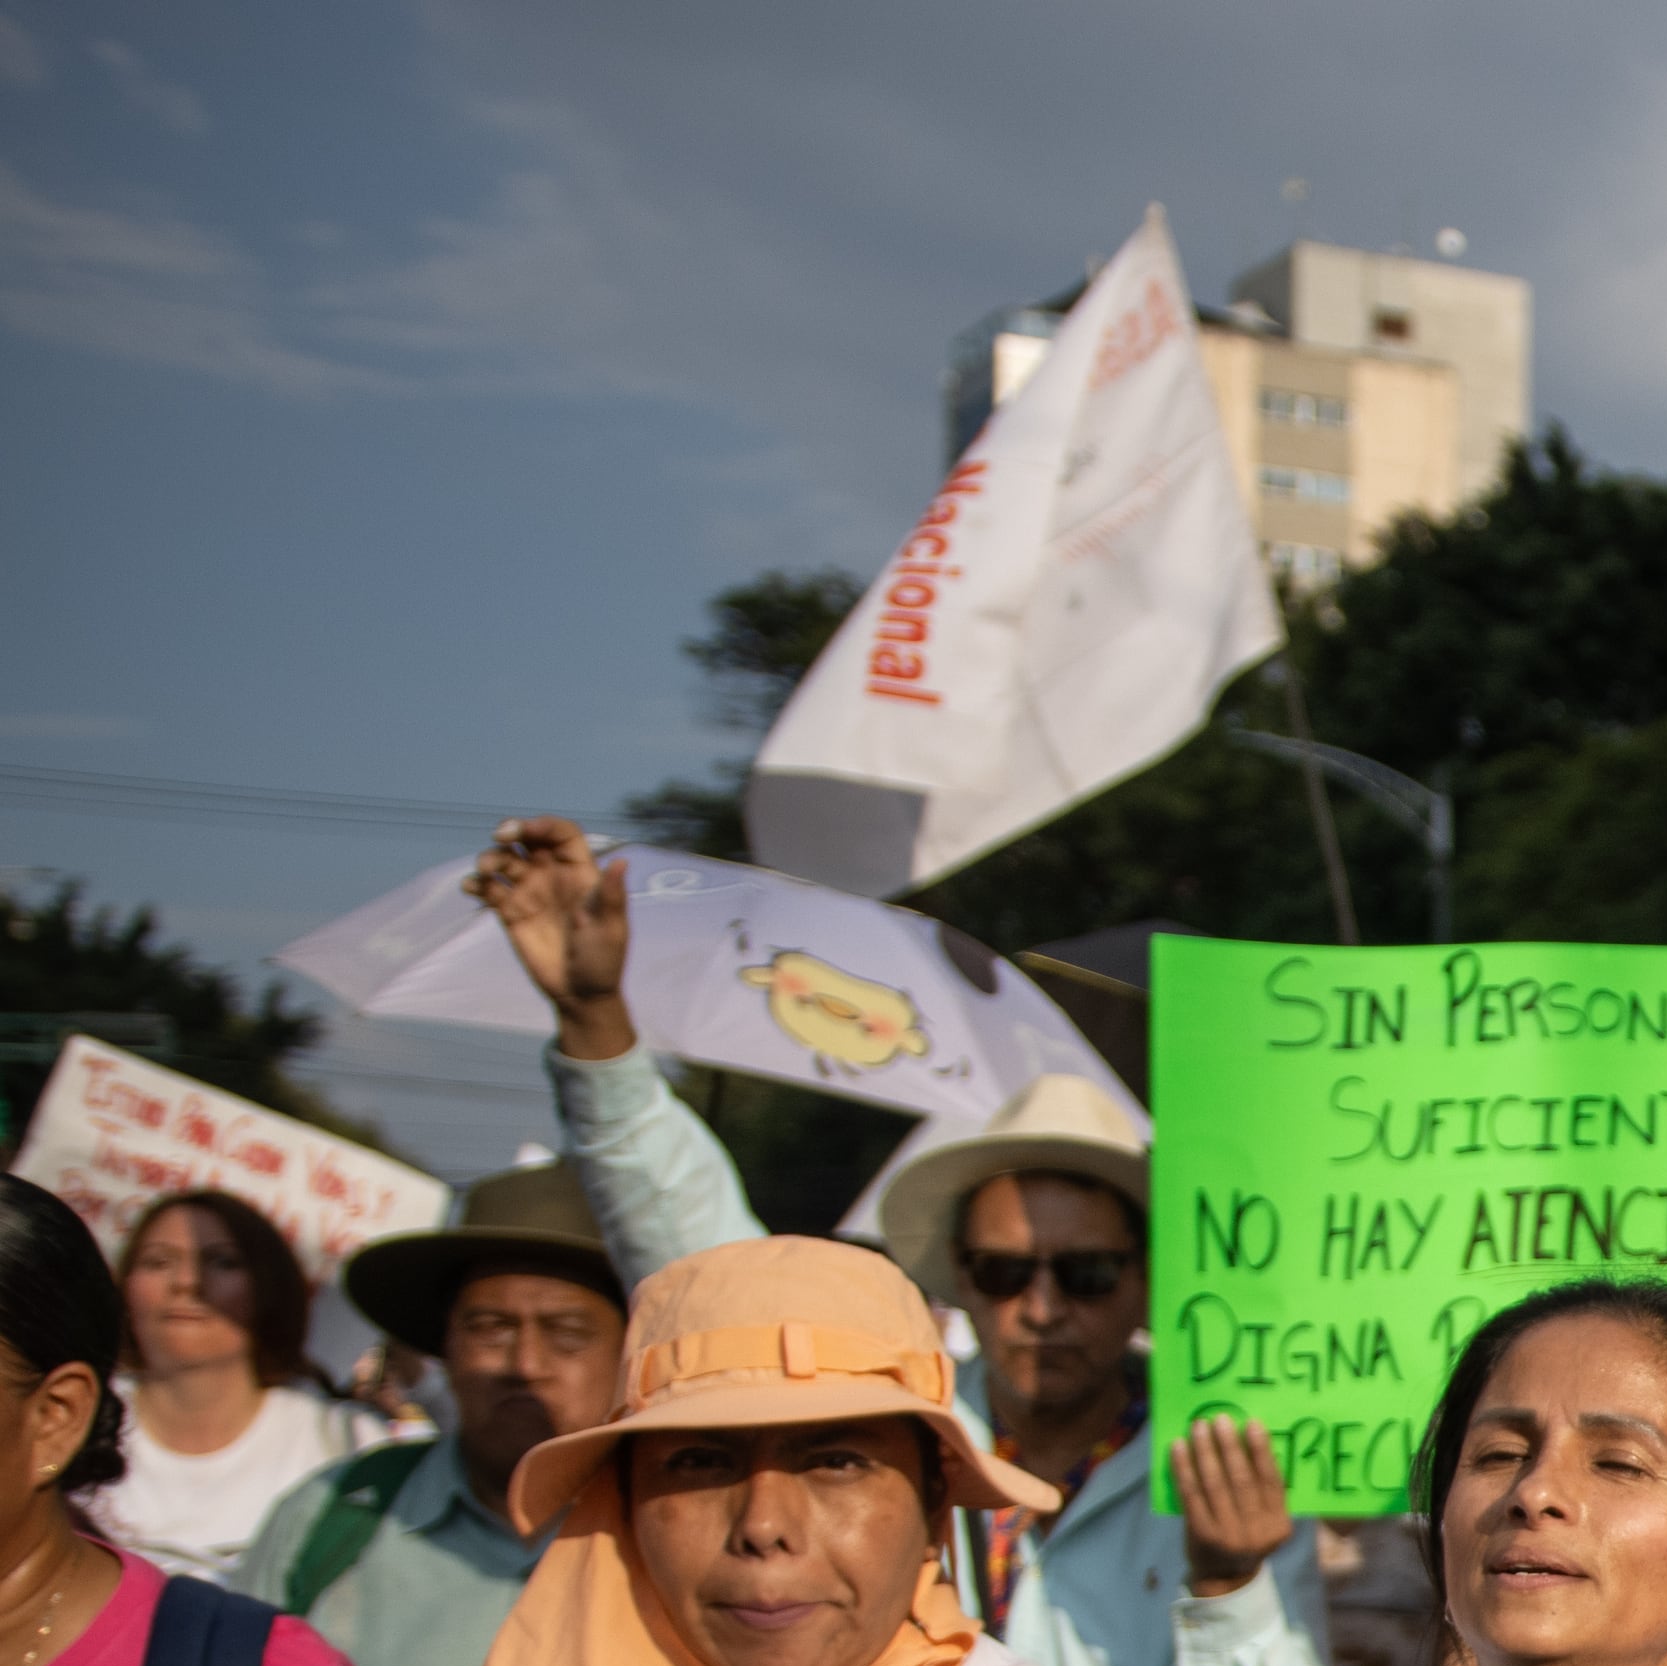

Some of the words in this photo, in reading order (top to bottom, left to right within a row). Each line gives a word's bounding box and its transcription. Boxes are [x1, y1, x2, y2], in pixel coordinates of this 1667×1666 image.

[1266, 955, 1404, 1050] SIN
[1196, 1186, 1281, 1272] NO
[1320, 1192, 1446, 1280] HAY
[1177, 1291, 1403, 1393] DIGNA
